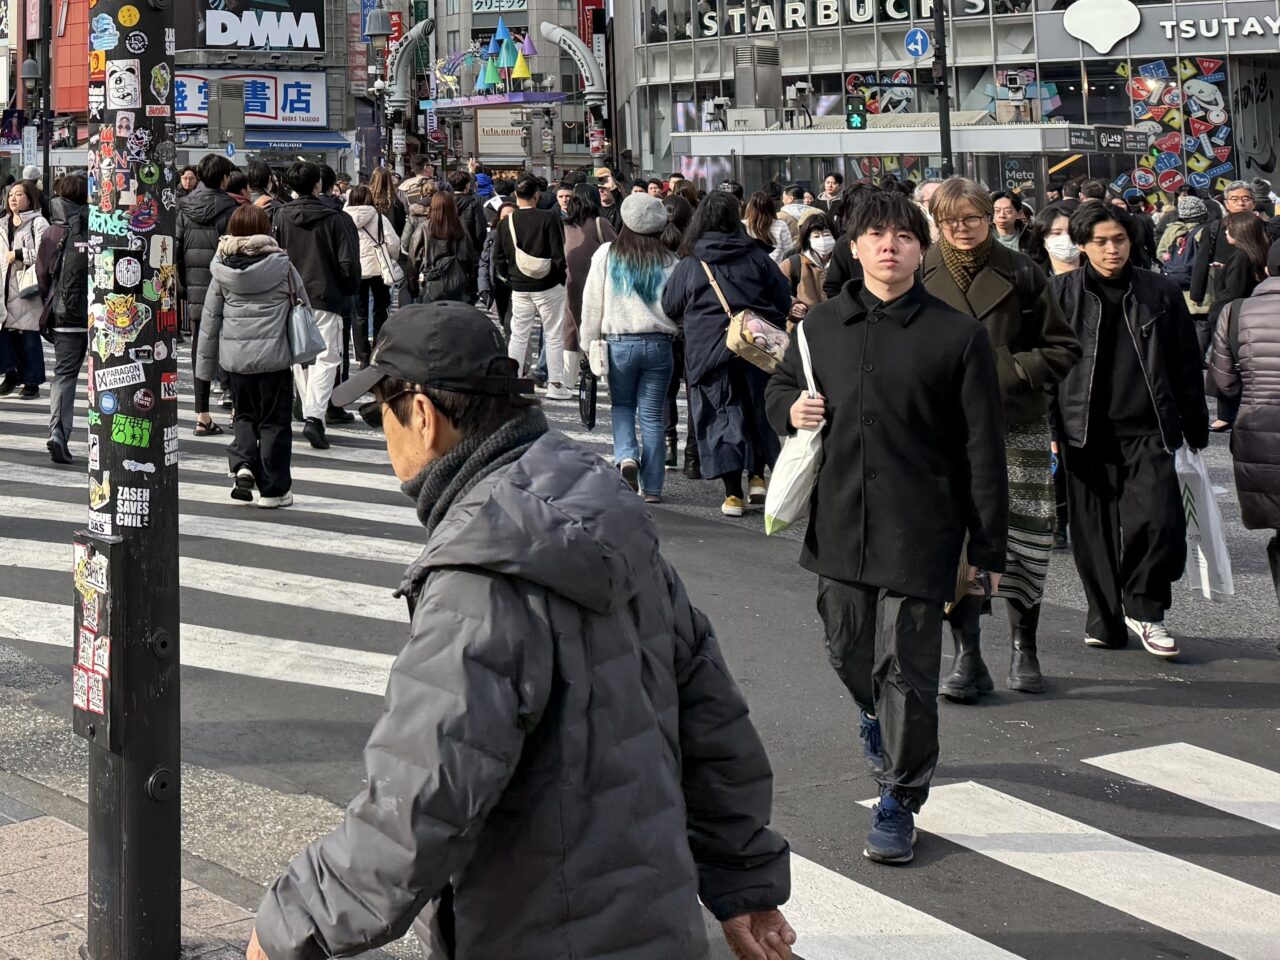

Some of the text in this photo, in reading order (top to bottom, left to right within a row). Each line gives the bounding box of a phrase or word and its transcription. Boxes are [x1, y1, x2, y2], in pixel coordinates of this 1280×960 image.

[206, 10, 320, 48] DMM
[1005, 170, 1035, 179] Meta
[106, 363, 140, 378] PARAGON
[108, 373, 141, 387] ARMORY
[117, 487, 150, 501] ZASEH
[116, 500, 149, 514] SAVES
